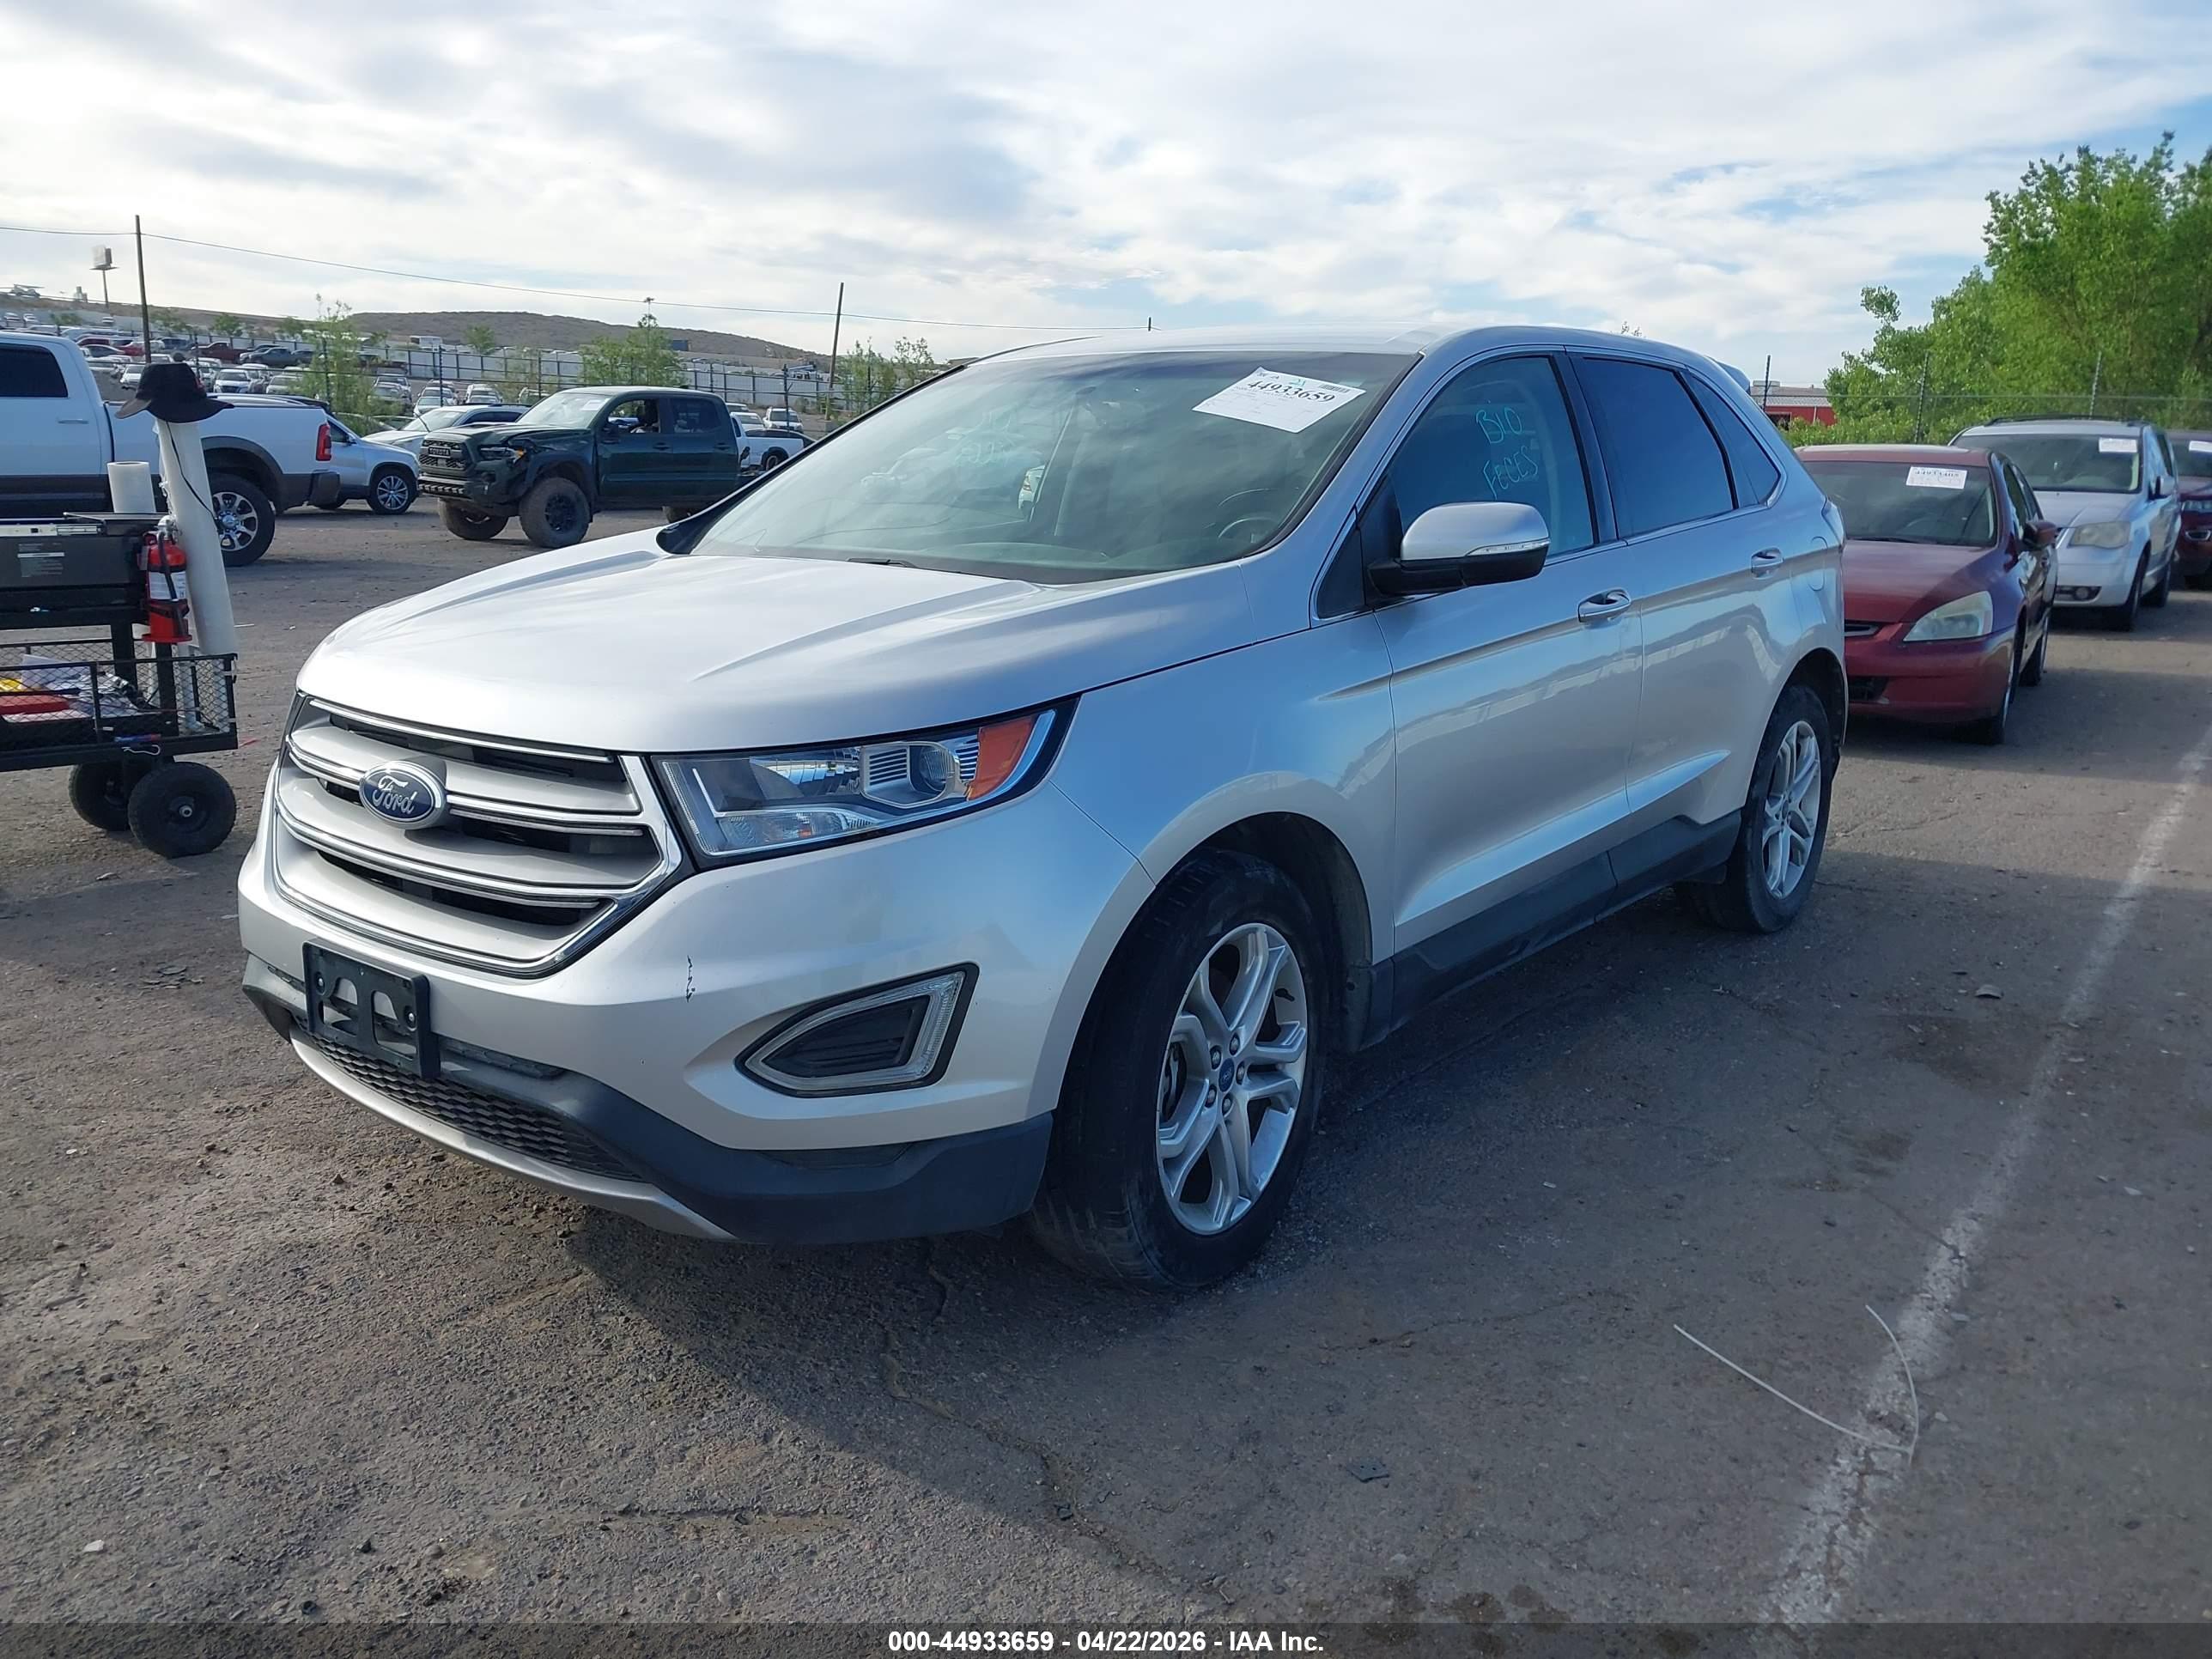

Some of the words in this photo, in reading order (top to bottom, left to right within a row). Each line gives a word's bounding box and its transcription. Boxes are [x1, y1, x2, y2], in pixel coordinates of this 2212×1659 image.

[1248, 380, 1336, 403] 44933659
[1475, 407, 1524, 444] BIO
[373, 775, 417, 814] Ford
